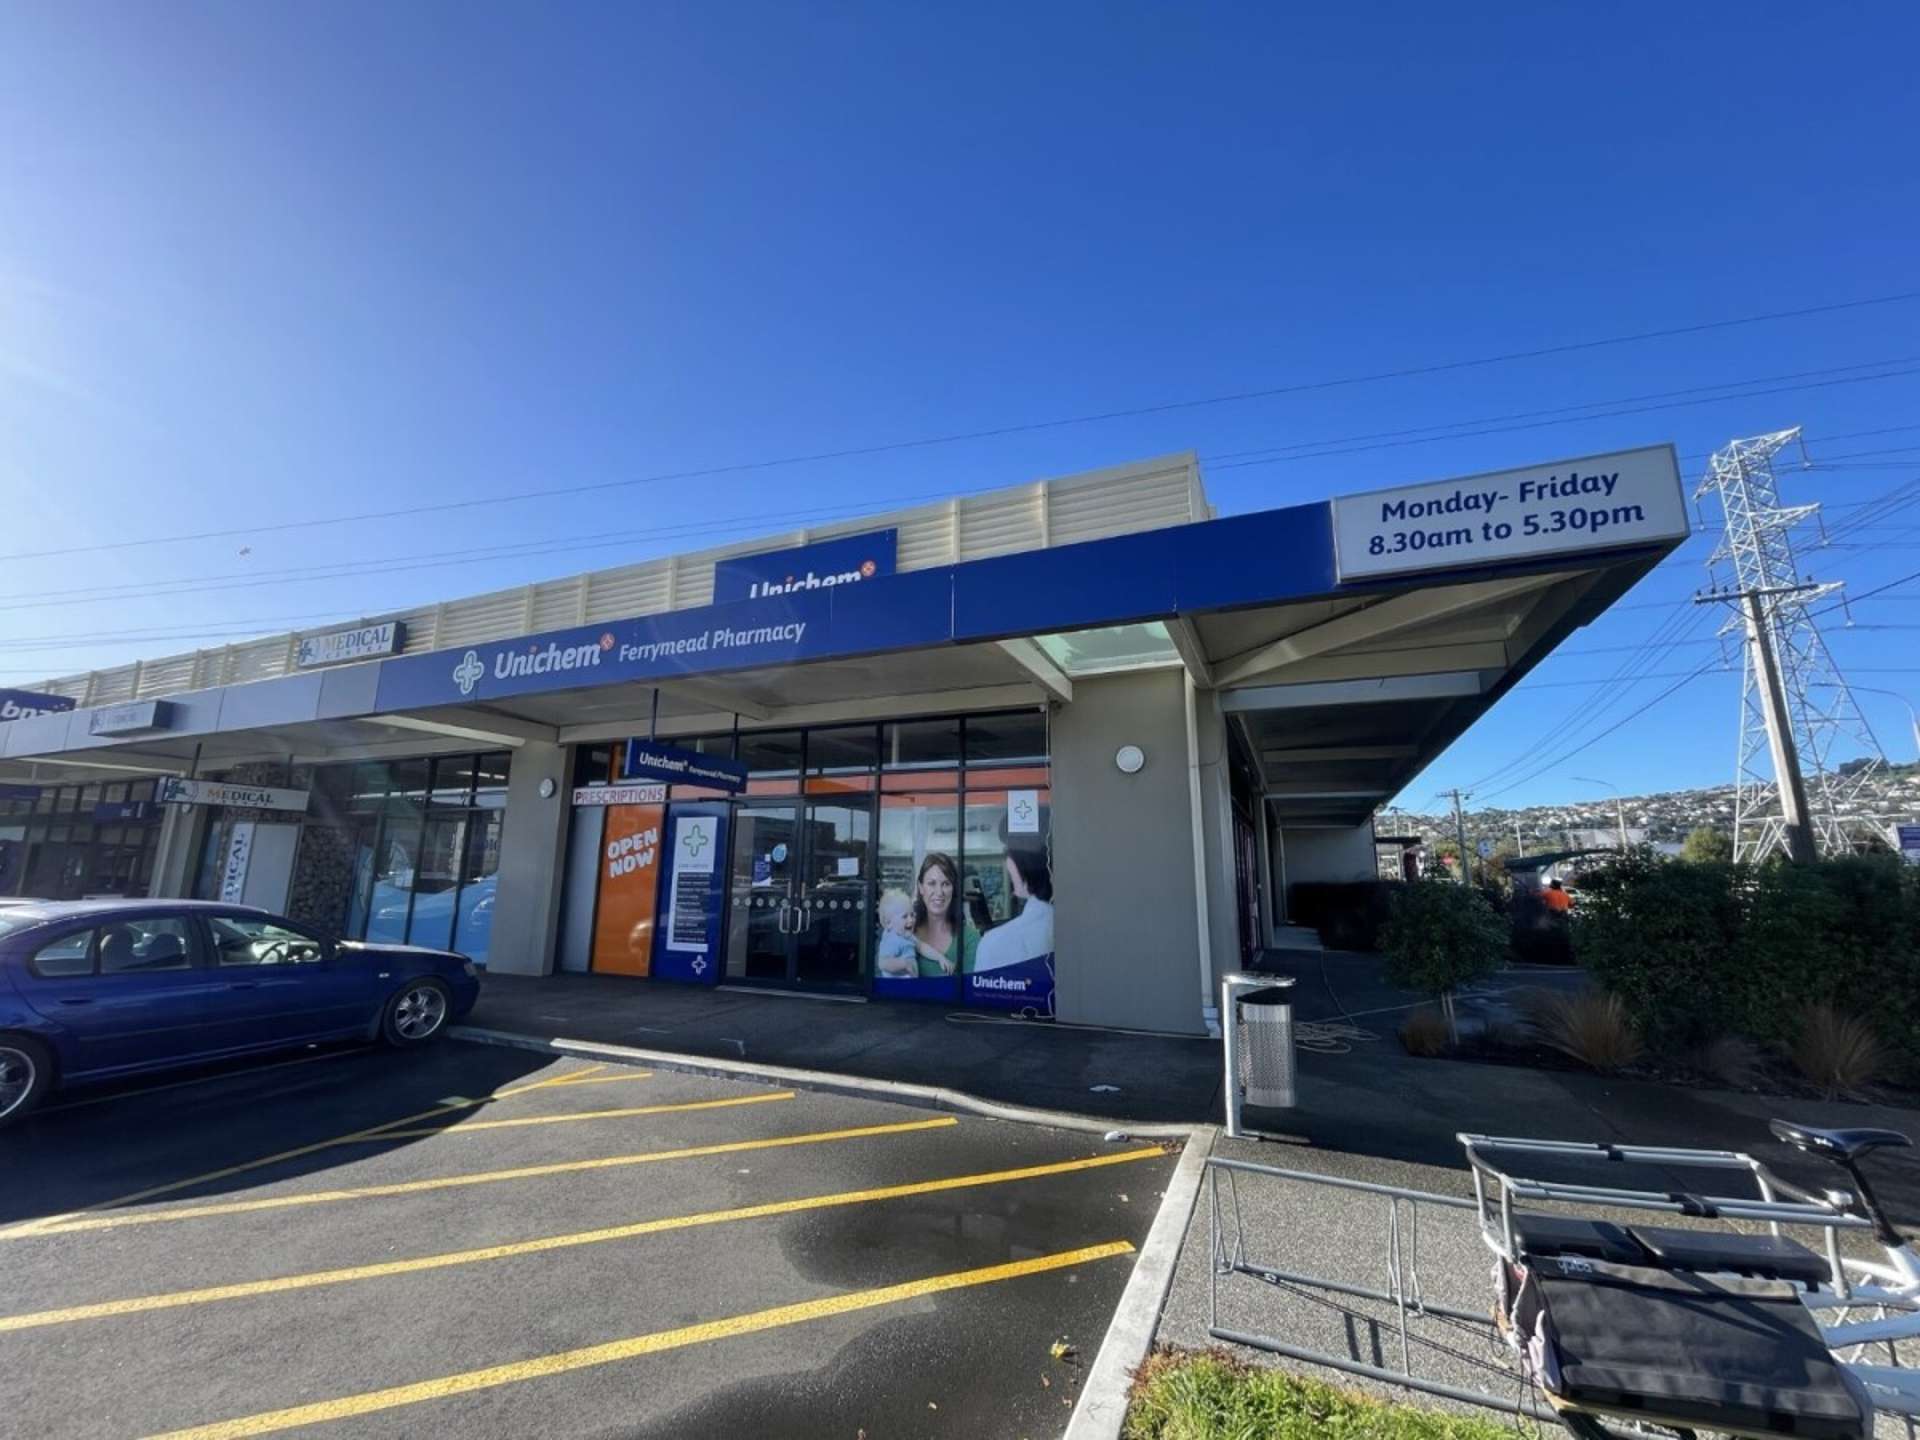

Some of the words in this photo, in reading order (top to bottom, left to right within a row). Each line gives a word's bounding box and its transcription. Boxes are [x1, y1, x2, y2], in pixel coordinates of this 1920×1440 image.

[1518, 472, 1619, 503] Friday
[1369, 528, 1473, 556] 8.30am
[1482, 520, 1513, 541] to
[1523, 503, 1645, 536] 5.30pm
[495, 642, 601, 679] Unichem
[619, 632, 708, 663] Ferrymead
[712, 621, 806, 650] Pharmacy
[575, 787, 664, 804] PRESCRIPTIONS
[608, 827, 657, 859] OPEN
[609, 847, 656, 879] NOW
[973, 975, 1026, 991] Unichem
